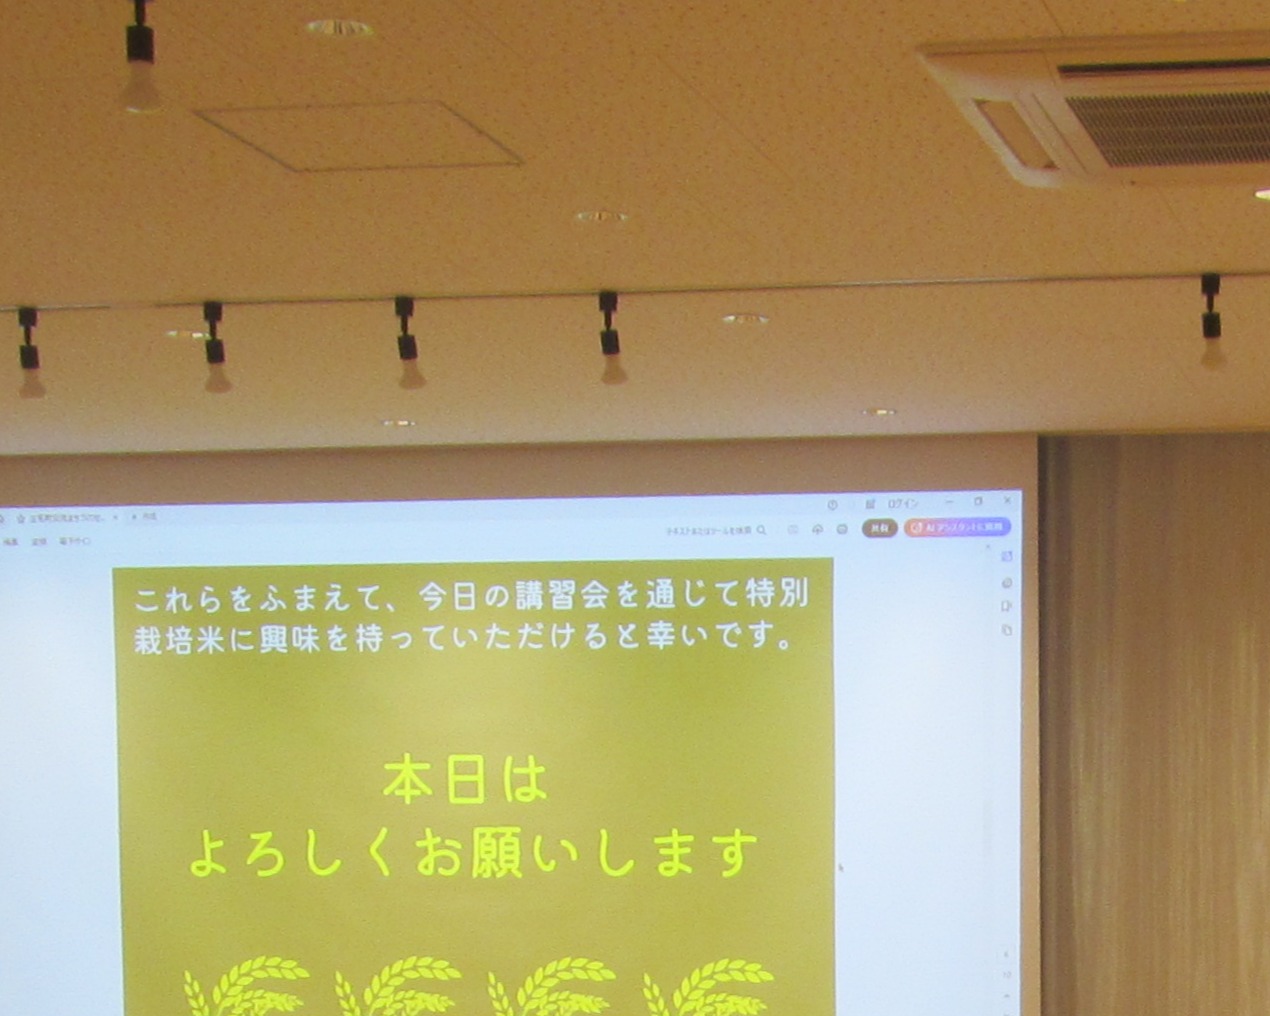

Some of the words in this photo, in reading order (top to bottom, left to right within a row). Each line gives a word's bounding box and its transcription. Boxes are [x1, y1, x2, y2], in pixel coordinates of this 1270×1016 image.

[133, 620, 789, 655] 栽培米に興味を持っていただけると幸いです。
[383, 753, 548, 805] 本日は
[190, 826, 759, 879] よろしくお願いします
